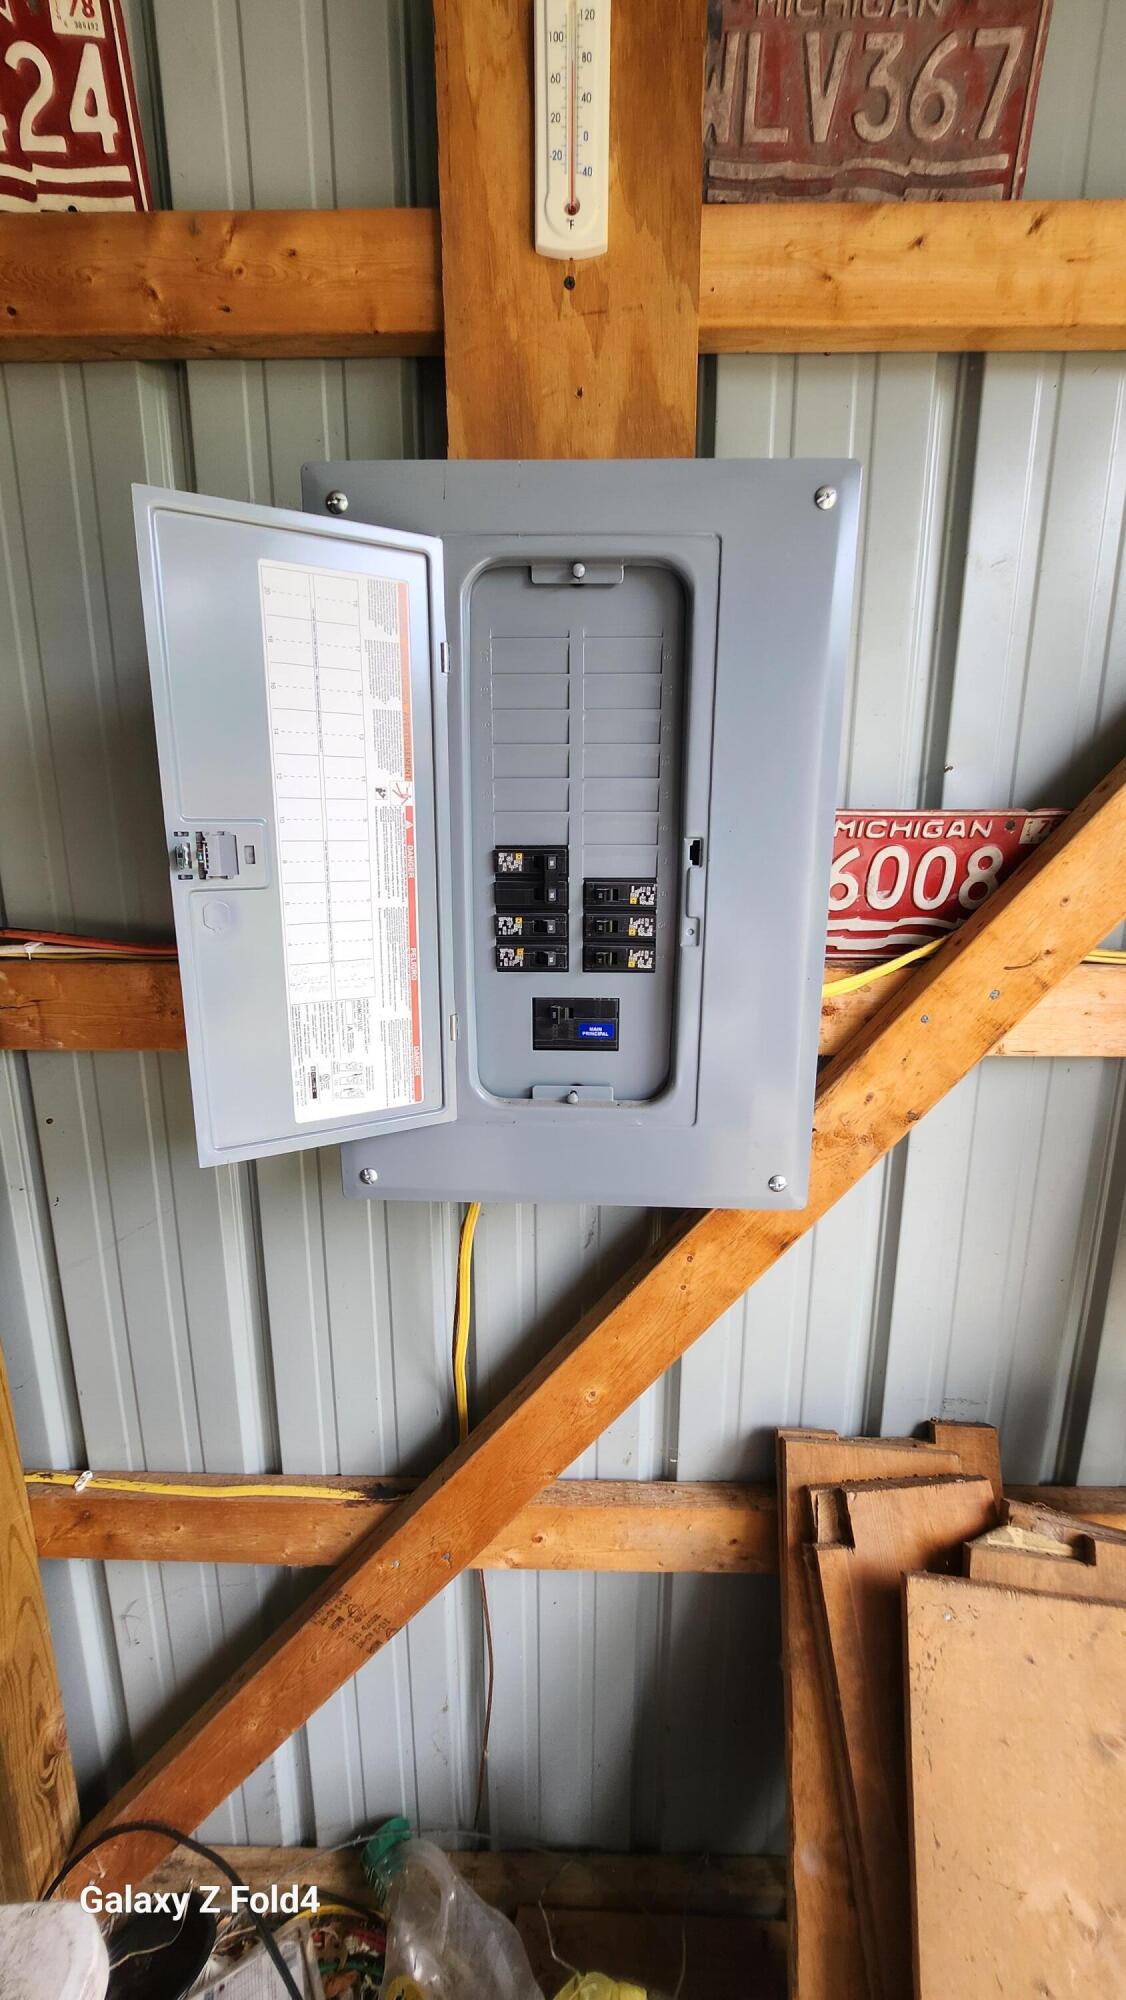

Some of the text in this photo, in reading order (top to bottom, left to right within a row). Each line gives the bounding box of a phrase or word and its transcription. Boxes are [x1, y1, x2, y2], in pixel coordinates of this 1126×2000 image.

[580, 9, 595, 20] 120
[756, 0, 945, 18] MICHIGAN
[549, 31, 564, 42] 100
[582, 52, 592, 63] 80
[550, 73, 561, 84] 60
[0, 40, 118, 154] 24
[582, 92, 592, 103] 40
[550, 112, 561, 123] 20
[583, 131, 589, 141] 0
[833, 819, 993, 839] MICHIGAN
[828, 845, 1003, 911] 6008
